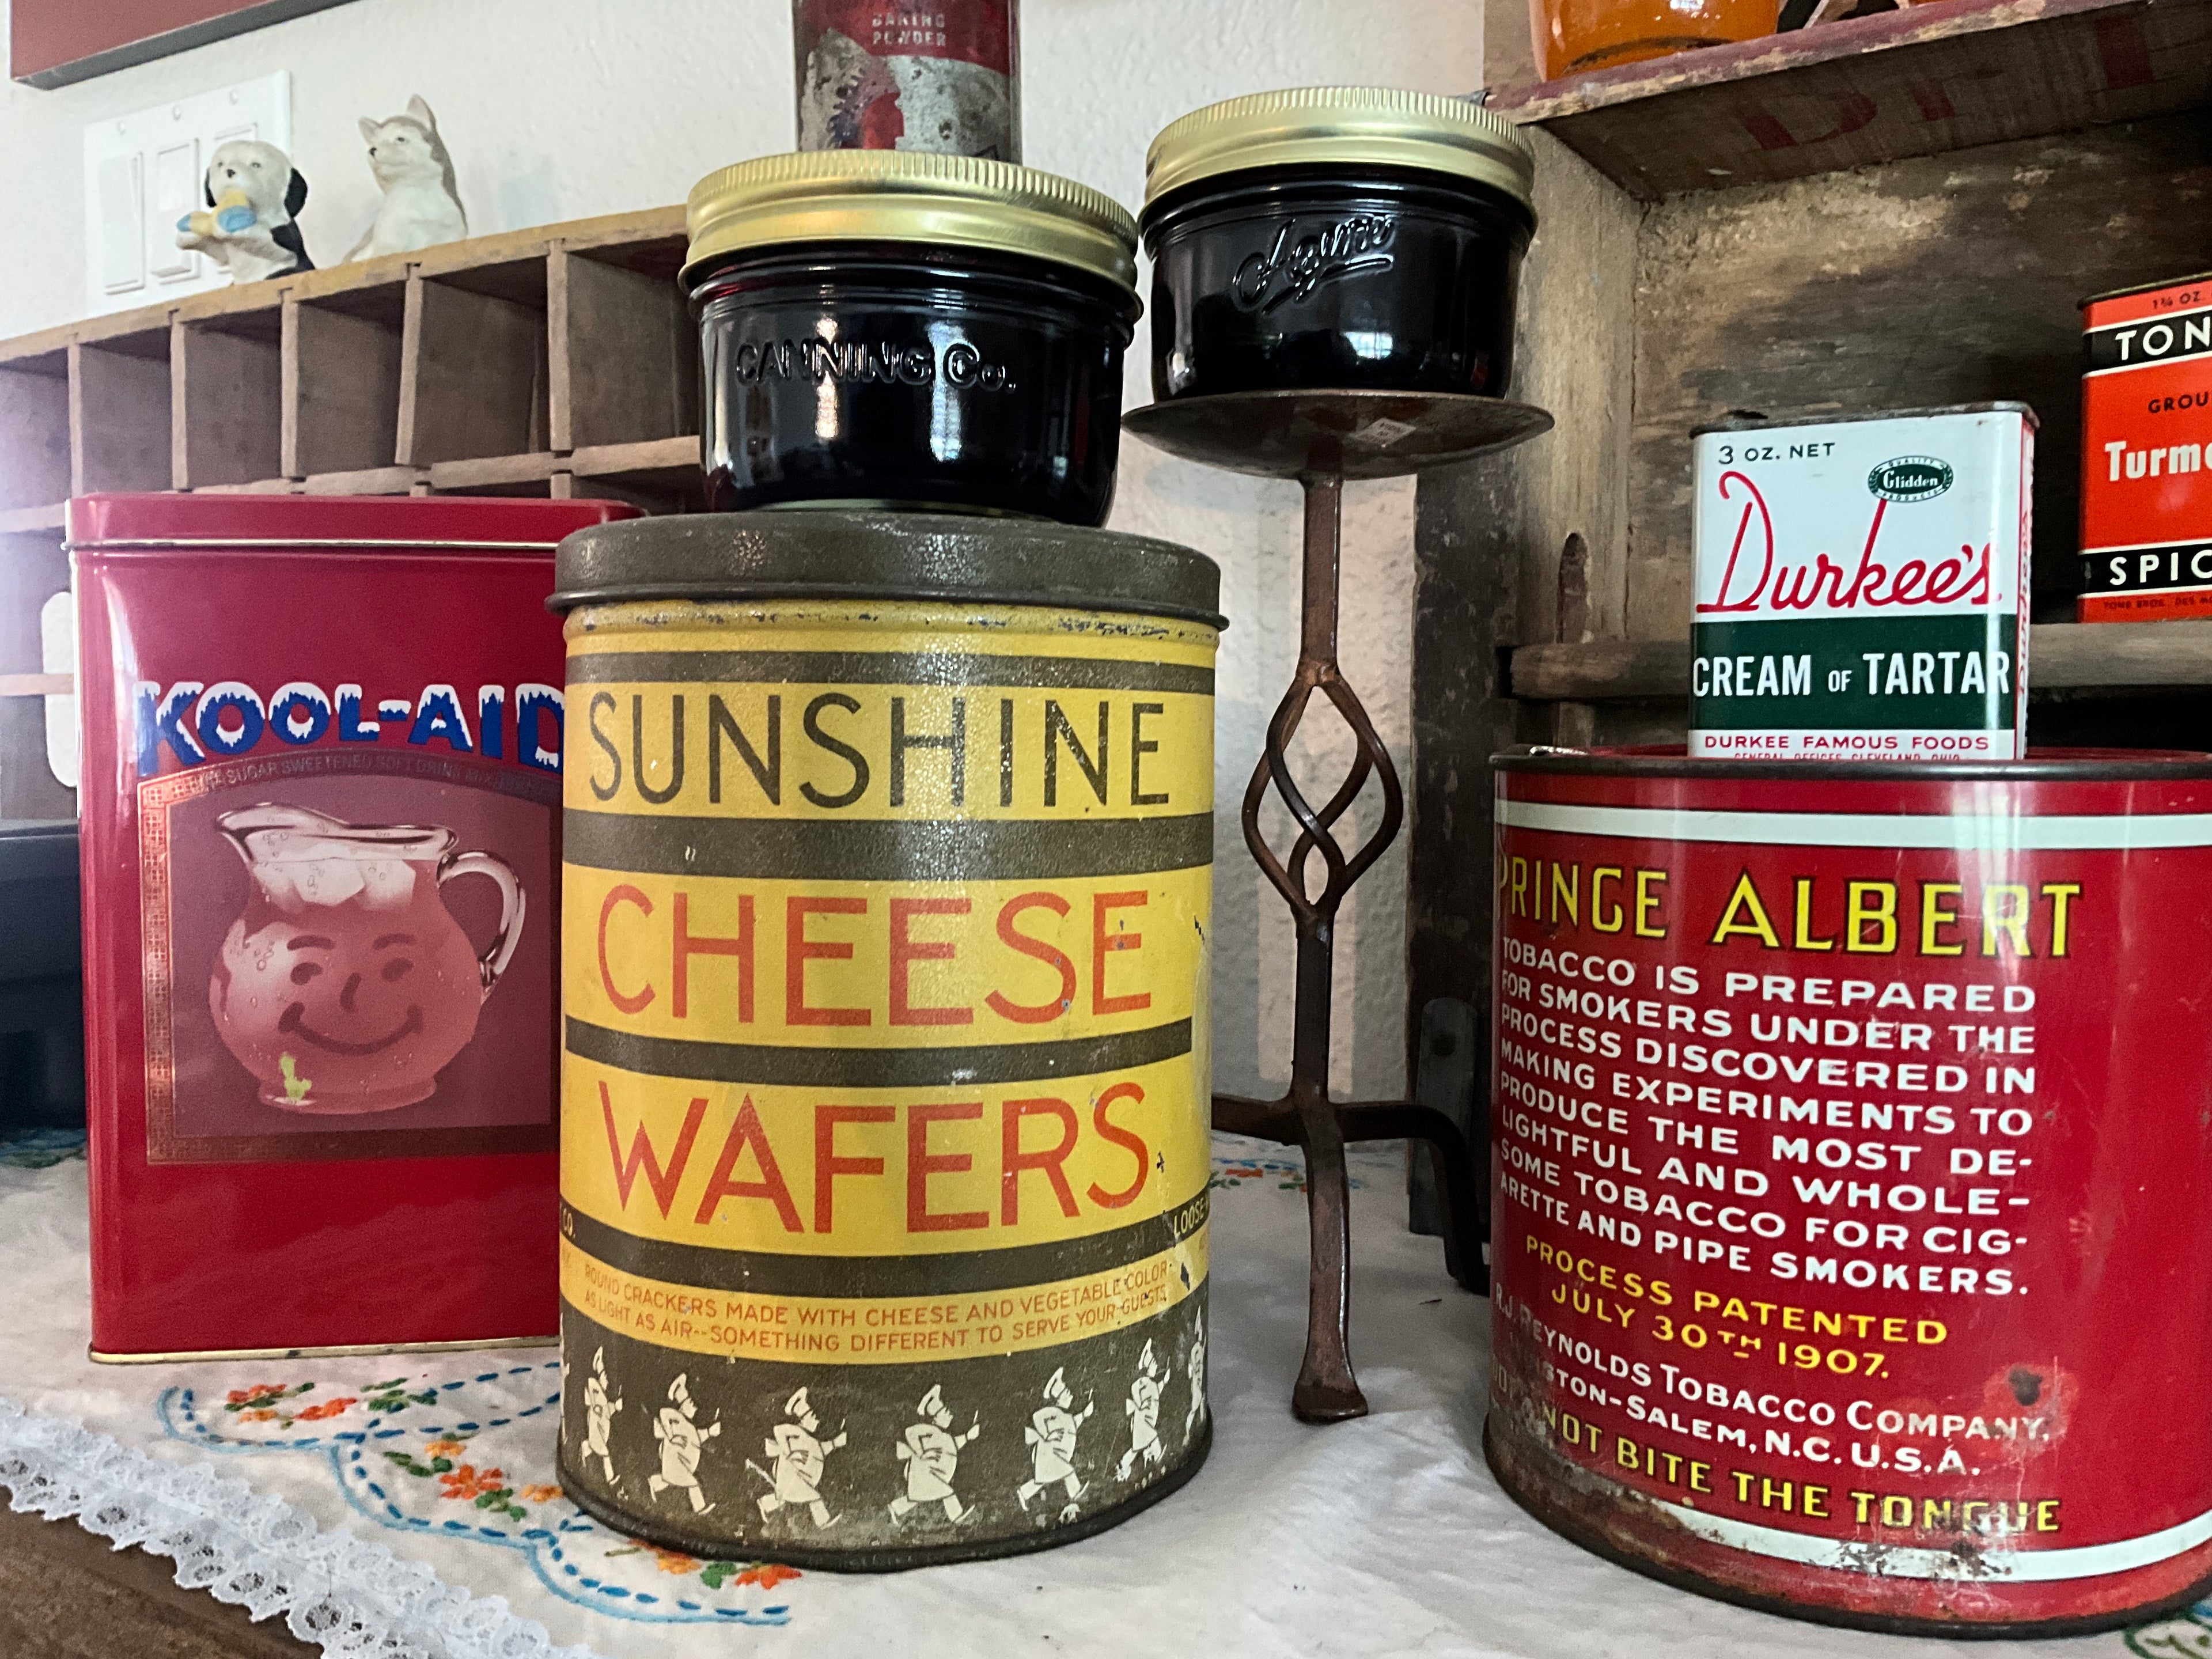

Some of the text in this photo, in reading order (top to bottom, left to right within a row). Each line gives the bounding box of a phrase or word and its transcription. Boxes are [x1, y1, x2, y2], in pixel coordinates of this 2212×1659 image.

[736, 339, 933, 385] CANNING
[2148, 391, 2209, 414] GROU
[1718, 442, 1836, 465] 3 OZ. NET
[1883, 470, 1938, 489] Glidden
[1696, 471, 2002, 613] Durkee's
[1693, 651, 2010, 697] CREAM OF TARTAR
[134, 681, 565, 778] KOOL-AID
[588, 691, 1170, 809] SUNSHINE
[1705, 736, 1989, 750] DURKEE FAMOUS FOODS
[597, 883, 1152, 1027] CHEESE
[1712, 874, 2081, 957] ALBERT
[1502, 937, 2036, 1012] TOBACCO IS PREPARED
[1502, 969, 2036, 1054] FOR SMOKERS UNDER THE
[1501, 1037, 2033, 1136] MAKING EXPERIMENTS TO
[1502, 1003, 2035, 1094] PROCESS DISCOVERED IN
[598, 1080, 1149, 1234] WAFERS
[1501, 1070, 2032, 1176] PRODUCE THE MOST DE-
[1501, 1109, 2030, 1215] LIGHTFUL AND WHOLE-
[1501, 1137, 2028, 1255] SOME TOBACCO FOR CIG-
[1501, 1171, 2028, 1295] ARETTE AND PIPE SMOKERS.
[585, 1260, 1168, 1327] ROUND CRACKERS MADE WITH CHEESE AND VEGETABLE COLOR
[585, 1289, 597, 1309] AS
[599, 1298, 631, 1324] LIGHT
[635, 1312, 656, 1331] AS
[851, 1328, 969, 1353] DIFFERENT
[978, 1324, 1003, 1344] TO
[1012, 1314, 1070, 1341] SERVE
[1075, 1304, 1116, 1330] YOUR
[1527, 1234, 1947, 1344] PROCESS PATENTED
[1551, 1283, 1635, 1329] JULY
[1778, 1342, 1889, 1378] 1907.
[1519, 1302, 1652, 1387] REYNOLDS
[1660, 1363, 1836, 1426] TOBACCO
[1542, 1400, 2060, 1532] NOT BITE THE TONGUE
[1765, 1429, 1842, 1465] N.C.
[1851, 1442, 1981, 1476] U.S.A.
